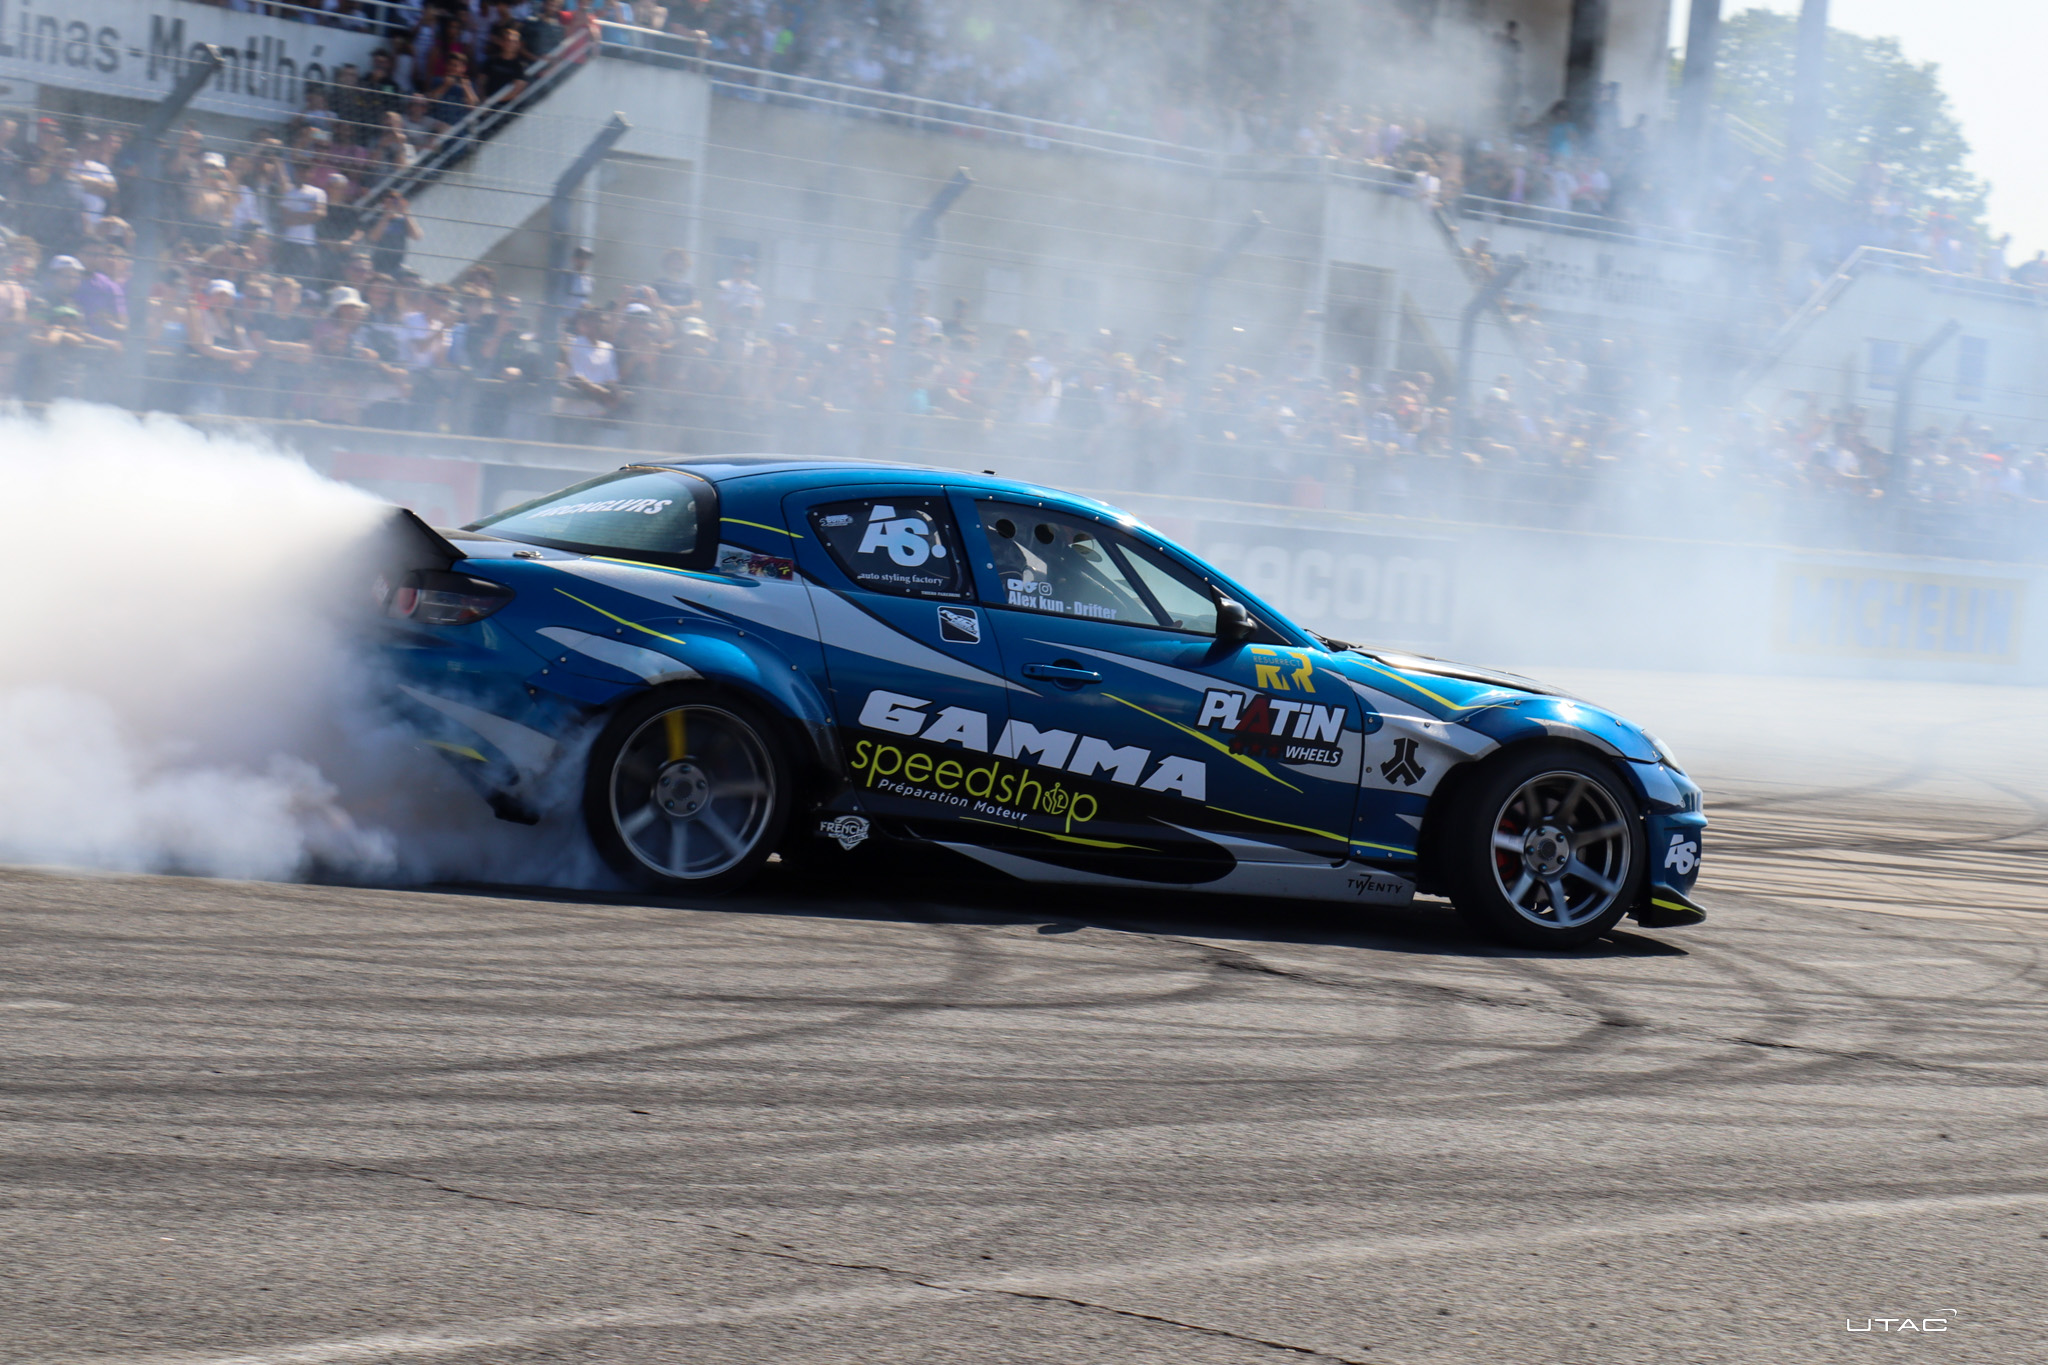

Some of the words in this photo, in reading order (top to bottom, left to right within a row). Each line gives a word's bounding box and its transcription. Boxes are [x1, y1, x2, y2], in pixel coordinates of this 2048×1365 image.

[881, 573, 911, 584] styling
[912, 574, 943, 586] factory
[1008, 591, 1037, 609] Alex
[1039, 596, 1064, 612] kun
[1074, 601, 1117, 620] Drifter
[1789, 575, 2016, 656] MICHELIN
[858, 689, 1206, 801] GAMMA
[1285, 745, 1340, 764] WHEELS
[877, 778, 969, 807] Préparation
[973, 800, 1028, 821] Moteur
